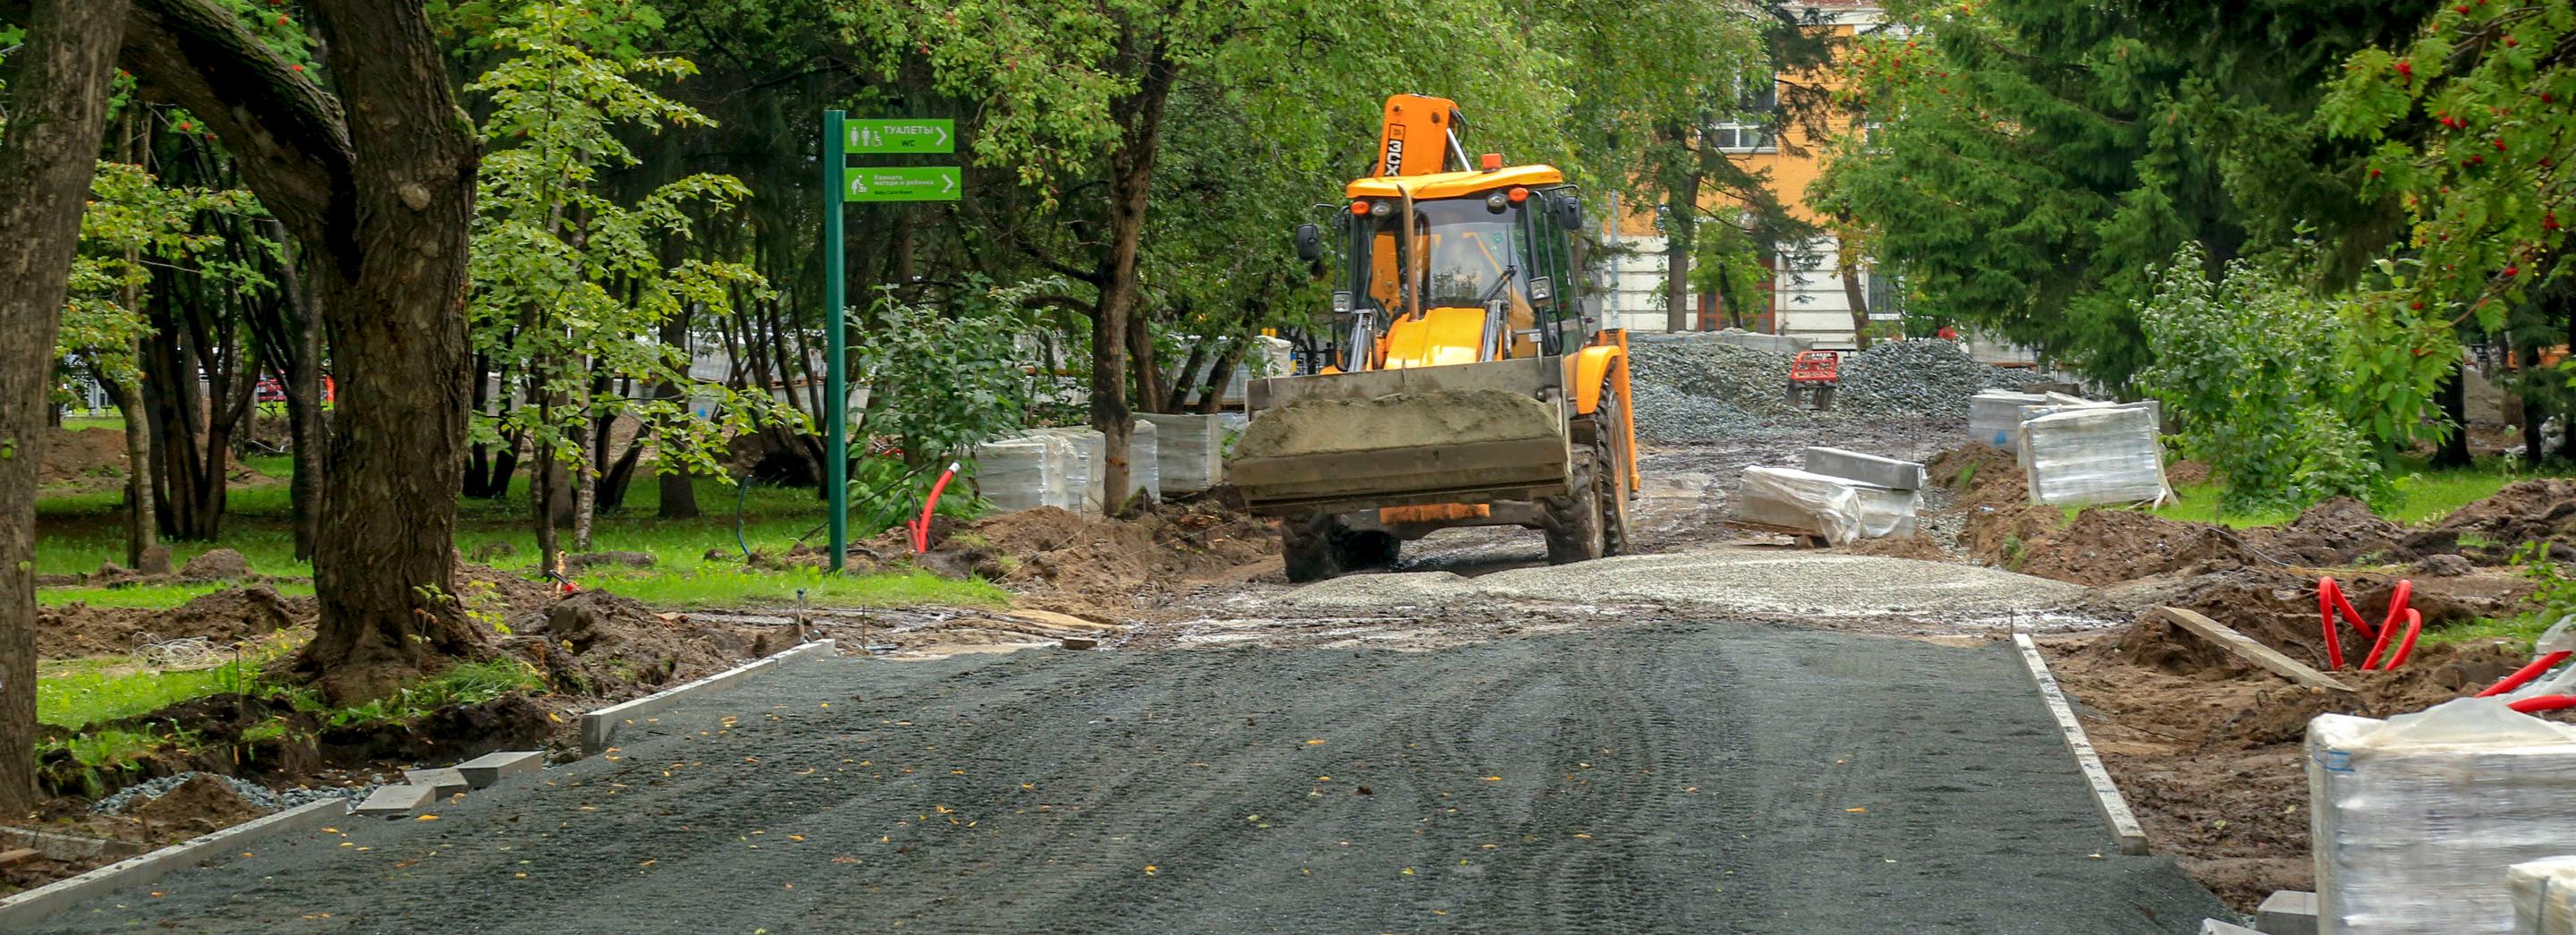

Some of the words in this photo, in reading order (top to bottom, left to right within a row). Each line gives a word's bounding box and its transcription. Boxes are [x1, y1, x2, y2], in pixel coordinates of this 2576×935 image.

[884, 125, 933, 134] ТУАЛЕТЫ
[901, 139, 915, 147] WC
[1385, 140, 1402, 176] 3CX
